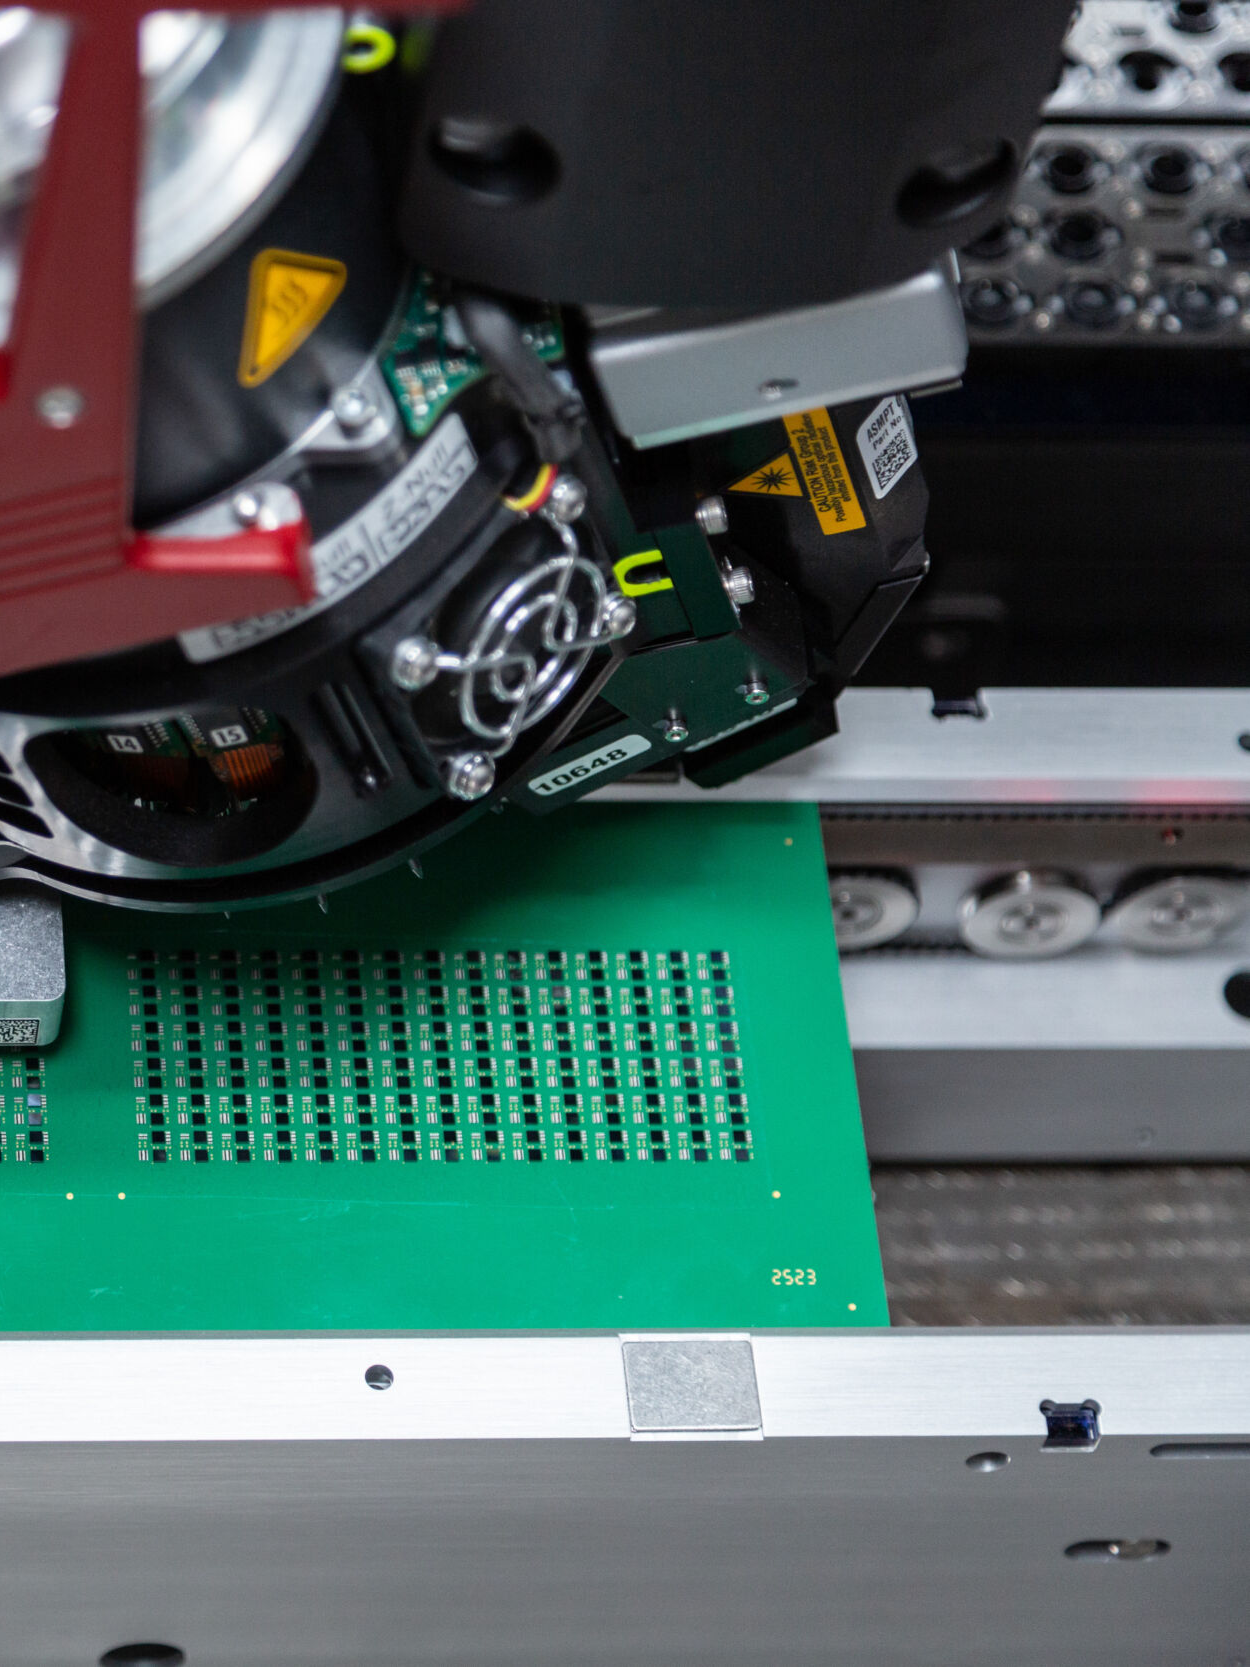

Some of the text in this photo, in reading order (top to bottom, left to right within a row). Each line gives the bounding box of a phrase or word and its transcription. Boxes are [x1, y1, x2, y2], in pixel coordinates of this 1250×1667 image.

[866, 401, 895, 443] ASMPT
[809, 476, 832, 513] CAUTION
[112, 737, 138, 751] 14
[216, 729, 242, 744] 15
[534, 748, 628, 792] 10648
[771, 1268, 817, 1286] 2523
